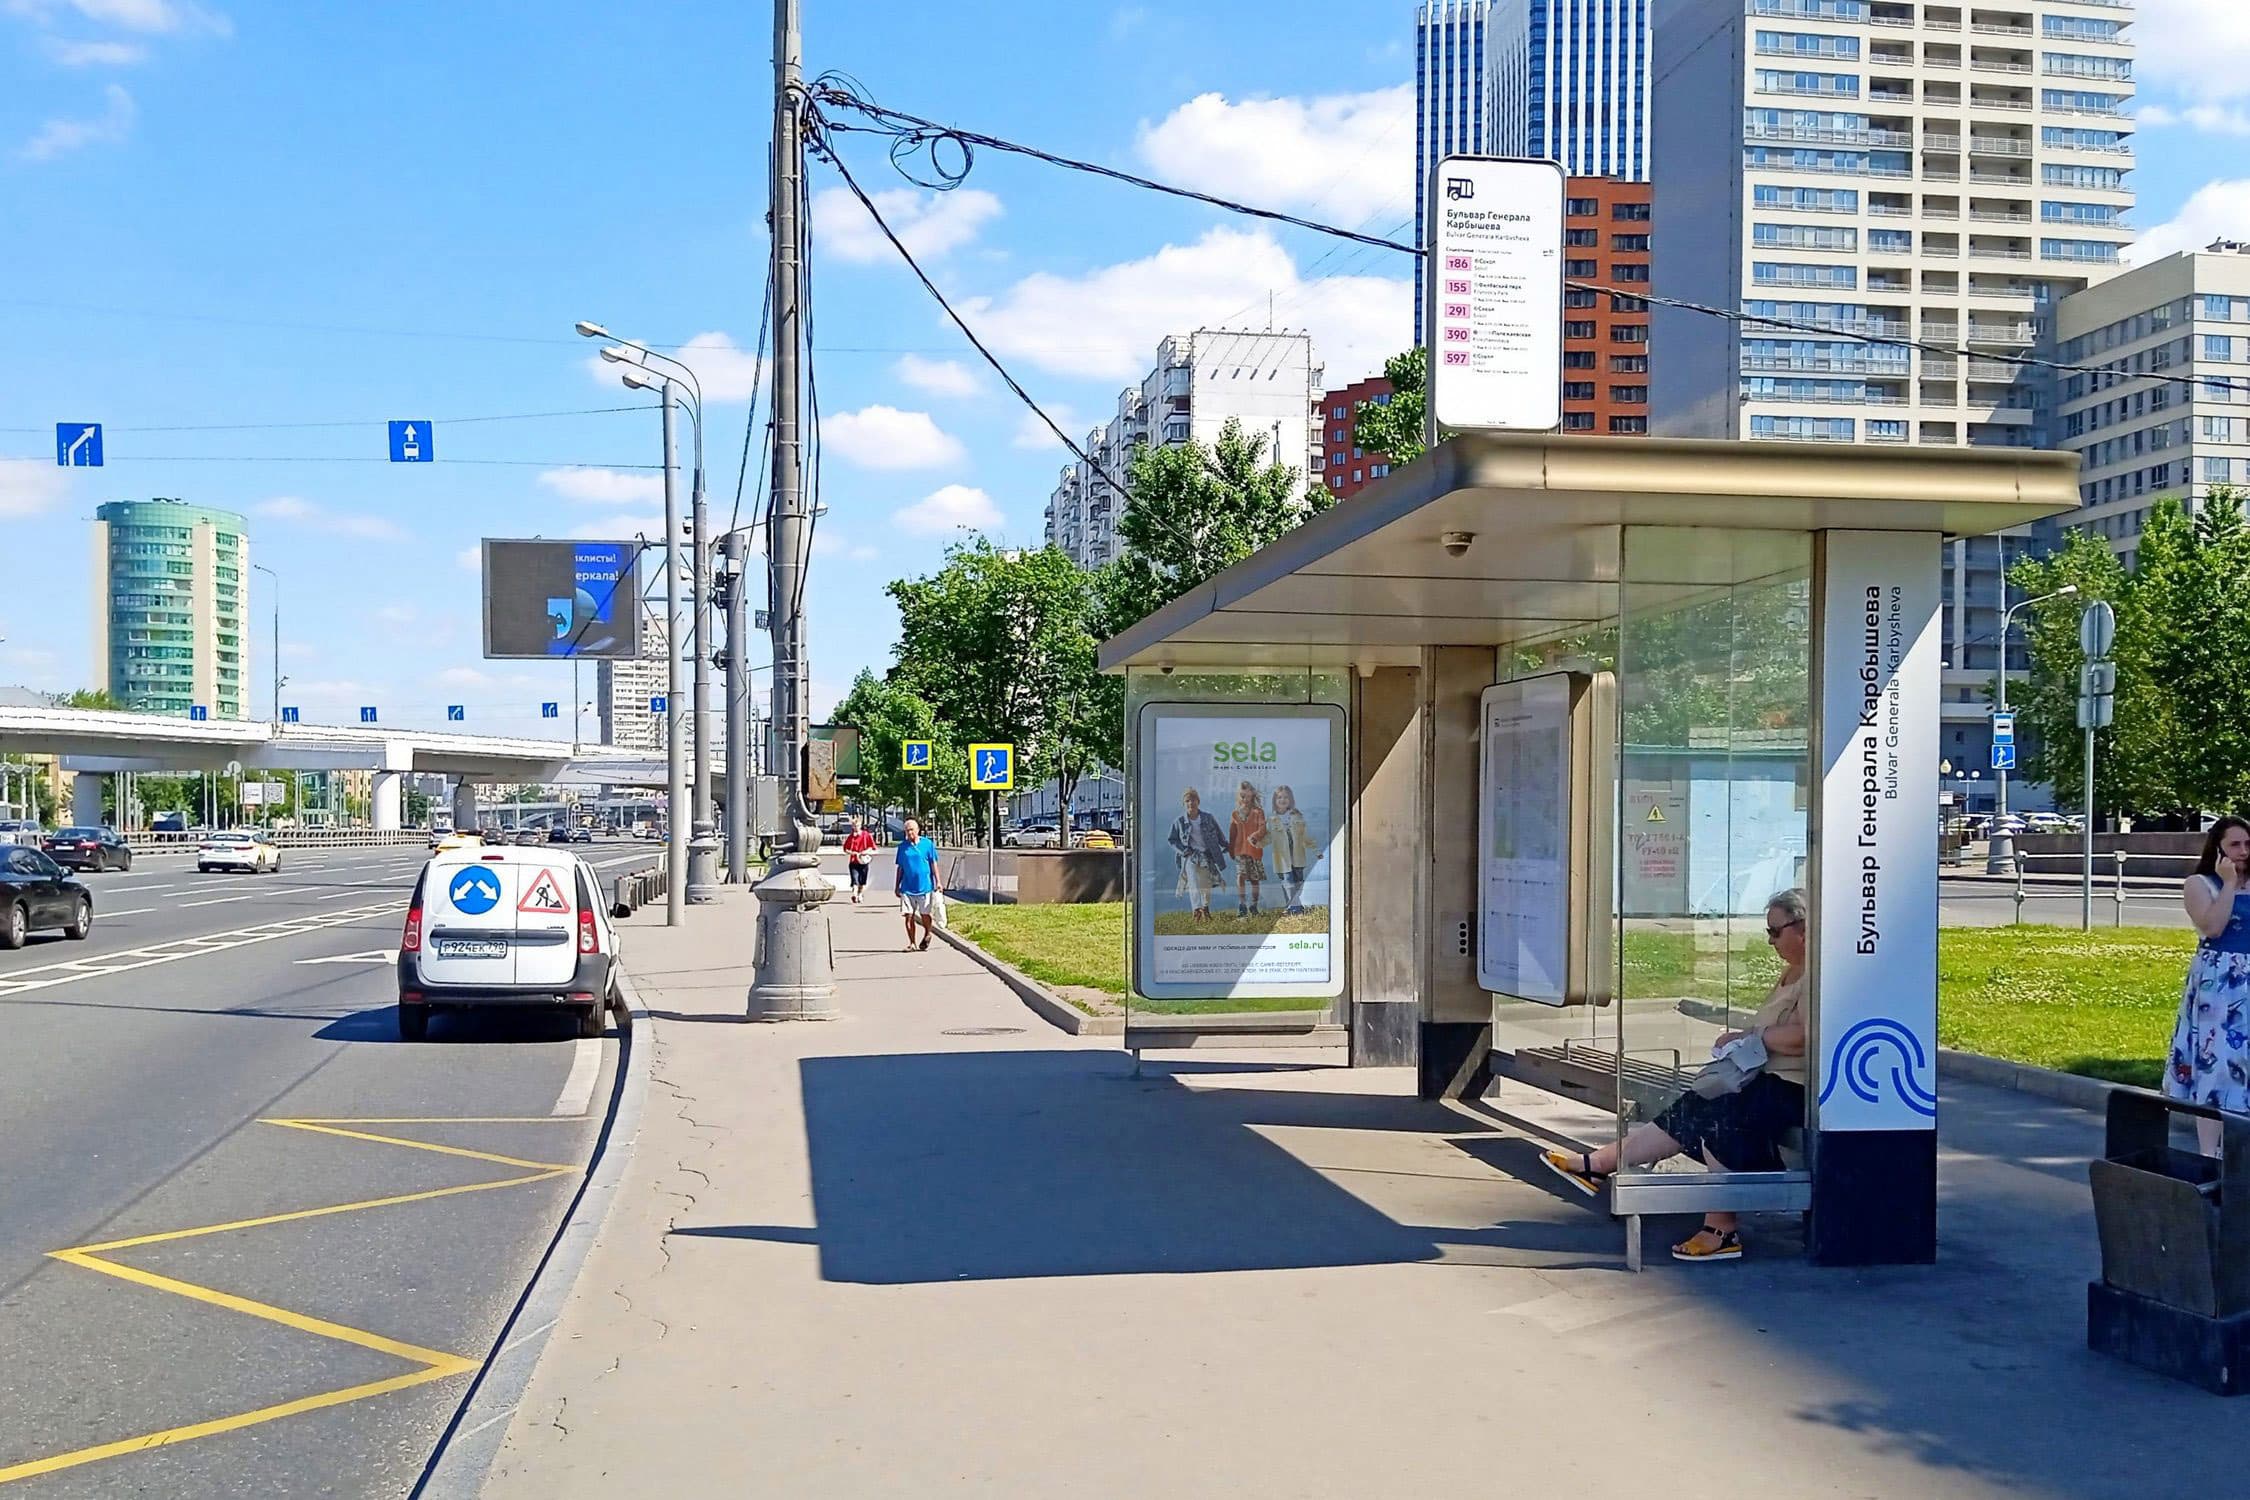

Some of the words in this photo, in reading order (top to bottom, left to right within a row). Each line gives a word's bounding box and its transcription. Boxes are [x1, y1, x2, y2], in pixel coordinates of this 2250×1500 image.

[1446, 220, 1501, 231] Карбышева
[1447, 209, 1485, 221] Бульвар
[1487, 211, 1531, 223] Генерала
[1449, 282, 1467, 292] 155
[1449, 306, 1466, 316] 291
[1447, 329, 1467, 340] 390
[1447, 353, 1467, 364] 597
[1886, 586, 1902, 674] Karbysheva
[1859, 586, 1883, 728] Карбышева
[1885, 679, 1900, 748] Generala
[1214, 736, 1277, 763] sela
[1884, 752, 1899, 799] Bulvar
[1858, 736, 1881, 848] Генерала
[1857, 856, 1880, 955] Бульвар
[1288, 940, 1324, 950] sela.ru
